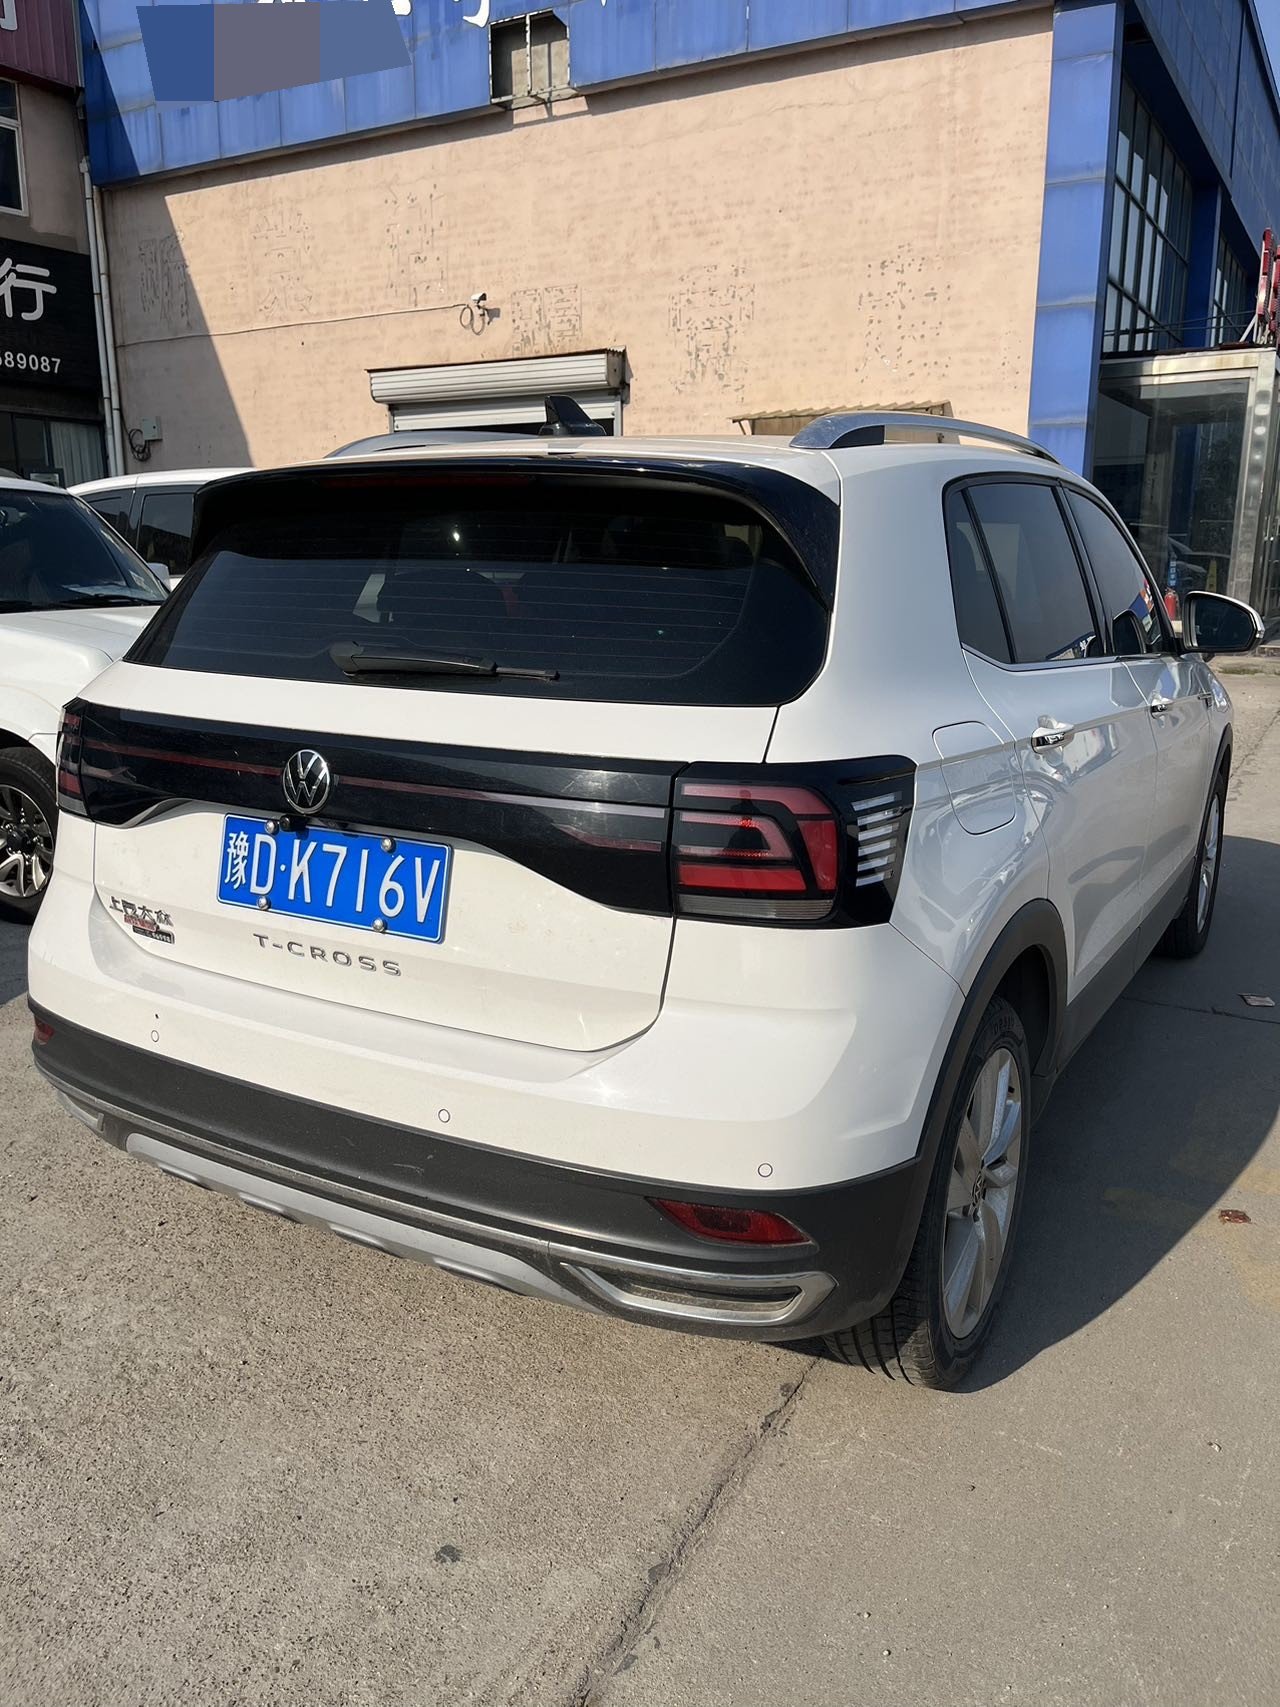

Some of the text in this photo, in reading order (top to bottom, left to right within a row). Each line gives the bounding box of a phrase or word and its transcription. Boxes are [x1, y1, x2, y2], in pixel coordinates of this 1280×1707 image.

[0, 257, 57, 321] 行
[0, 350, 61, 374] 89087
[225, 831, 441, 924] 豫D·K716V
[253, 932, 402, 977] T-CROSS
